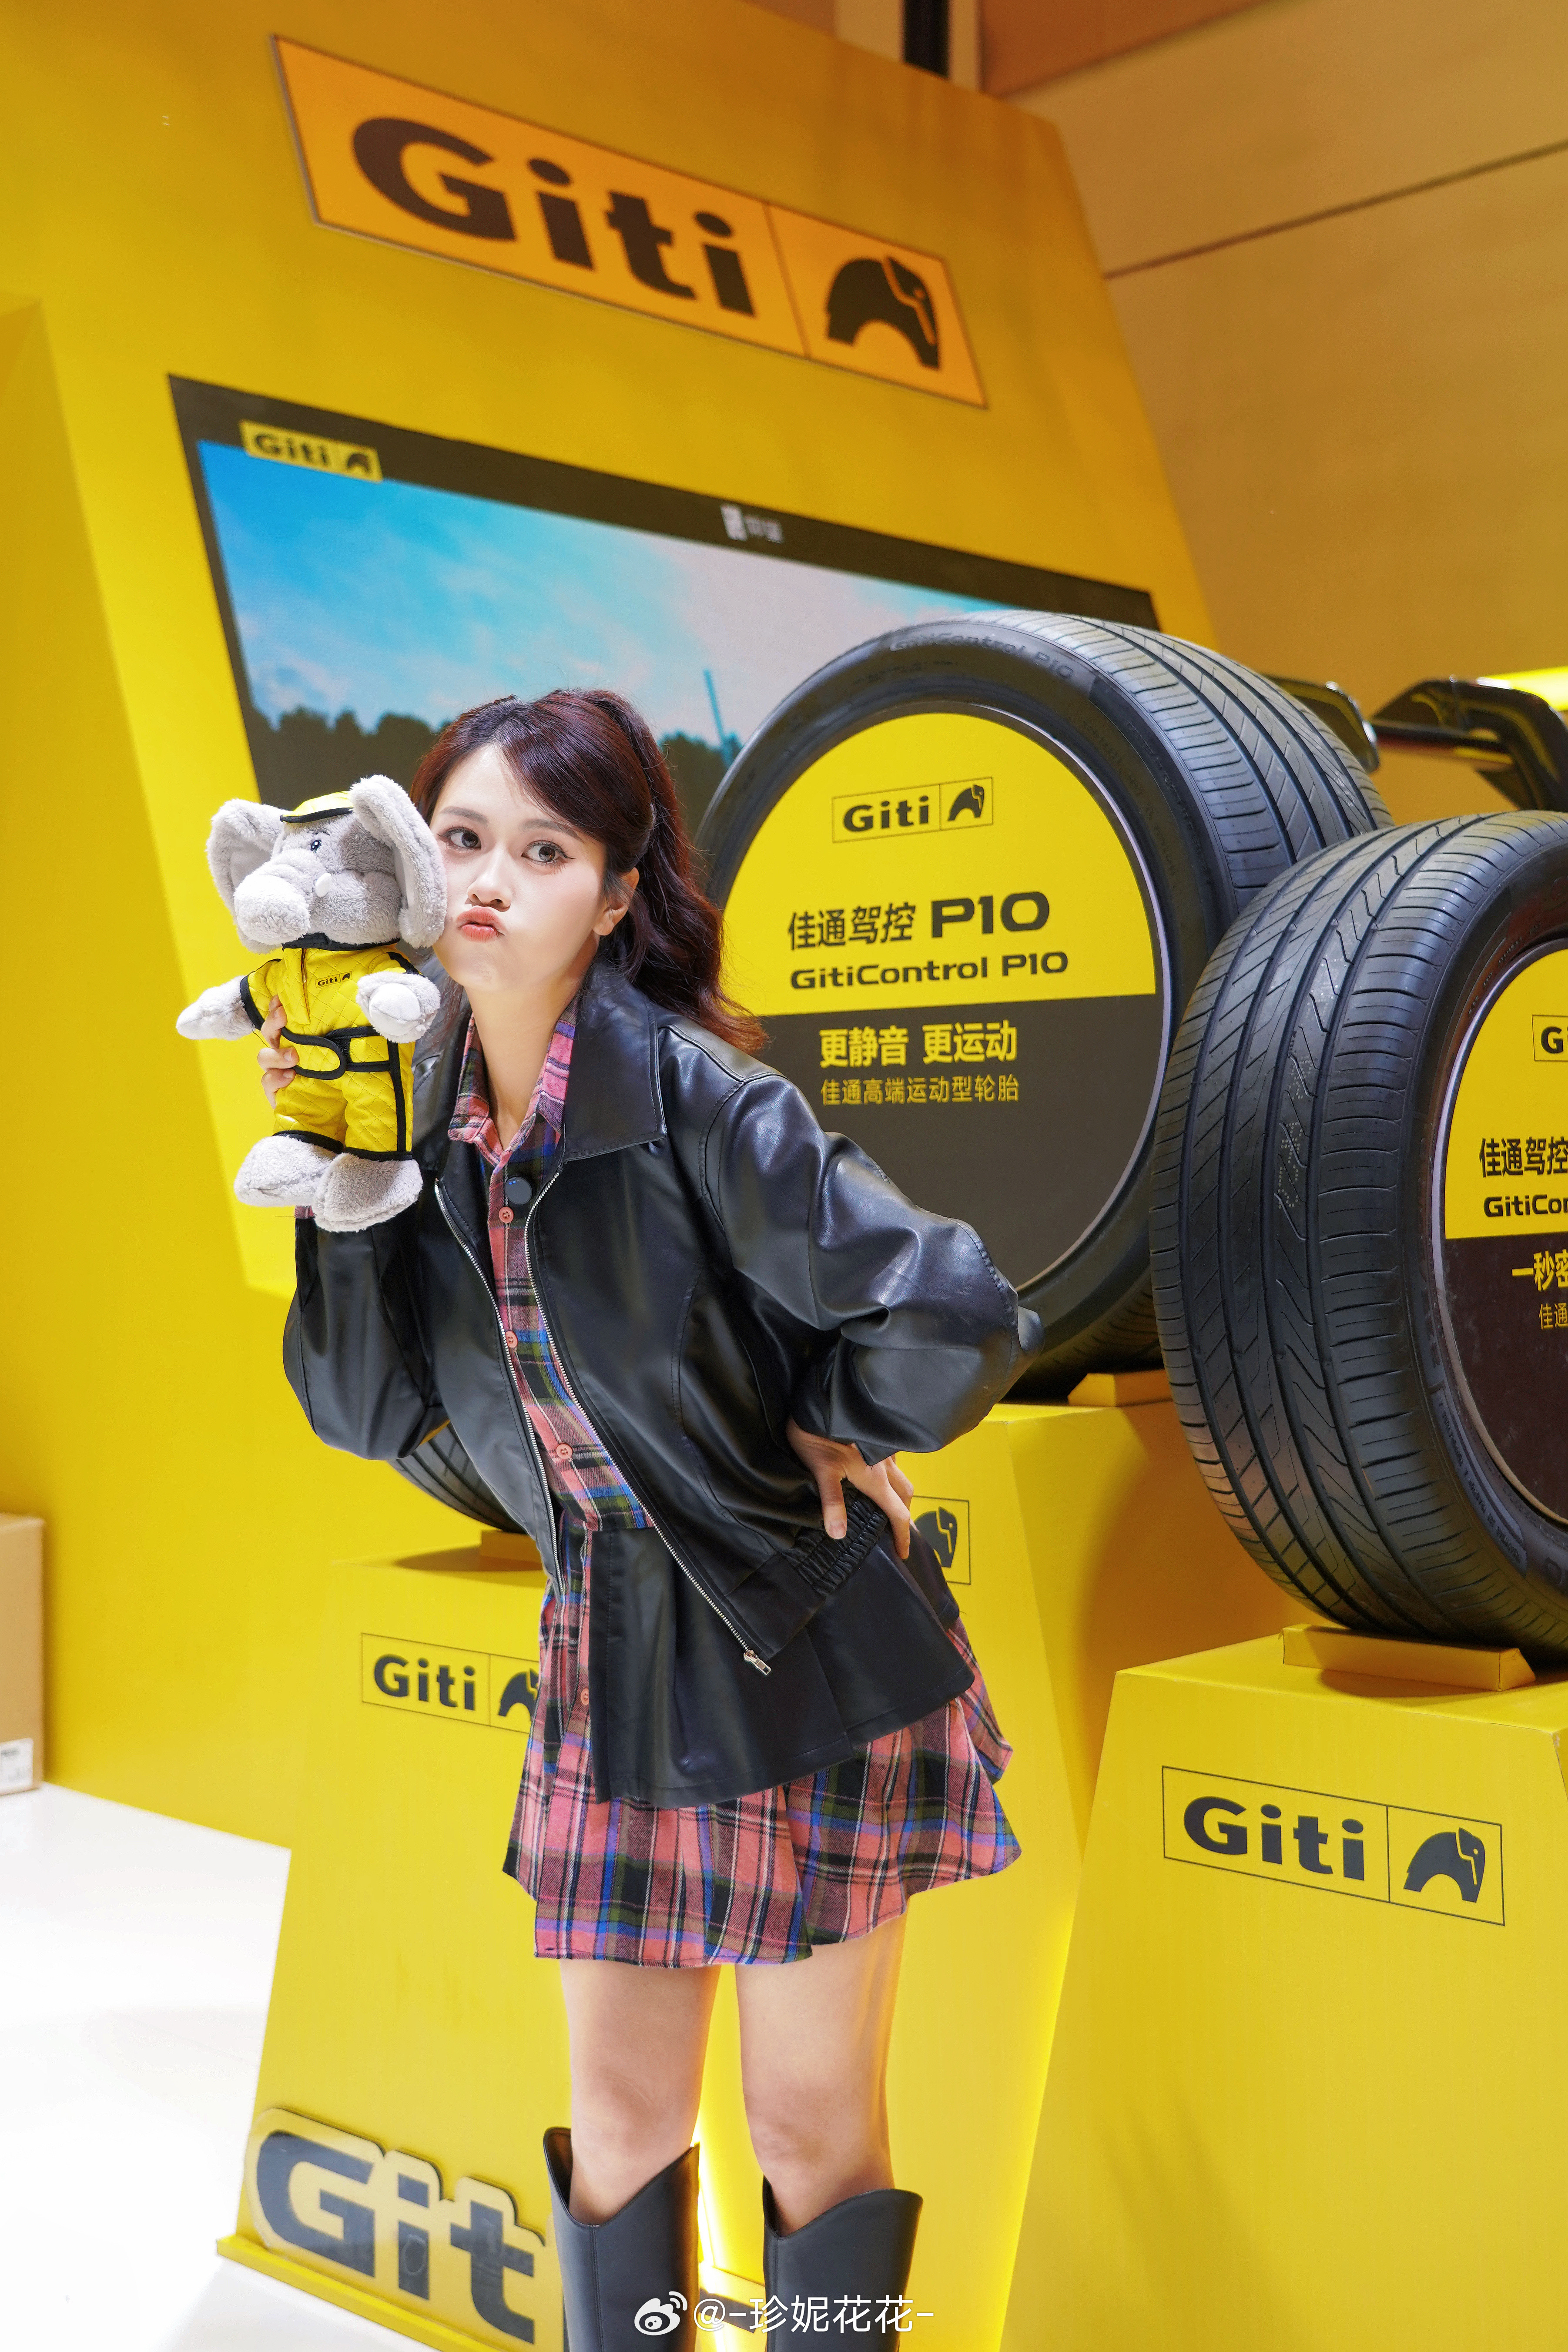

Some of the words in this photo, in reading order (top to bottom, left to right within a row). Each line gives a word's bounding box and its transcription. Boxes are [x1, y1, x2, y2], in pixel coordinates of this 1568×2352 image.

[352, 117, 755, 318] Giti
[255, 434, 329, 466] Giti
[843, 796, 929, 832] Giti
[788, 902, 916, 951] 佳通驾控
[931, 891, 1050, 938] P10
[318, 977, 338, 986] Giti
[790, 957, 988, 989] GitiControl
[1002, 951, 1069, 977] P10
[819, 1025, 909, 1068] 更静音
[922, 1019, 1017, 1064] 更运动
[820, 1072, 1019, 1106] 佳通高端运动型轮胎
[374, 1654, 476, 1711] Giti
[1183, 1796, 1365, 1881] Giti
[257, 2129, 570, 2352] Git
